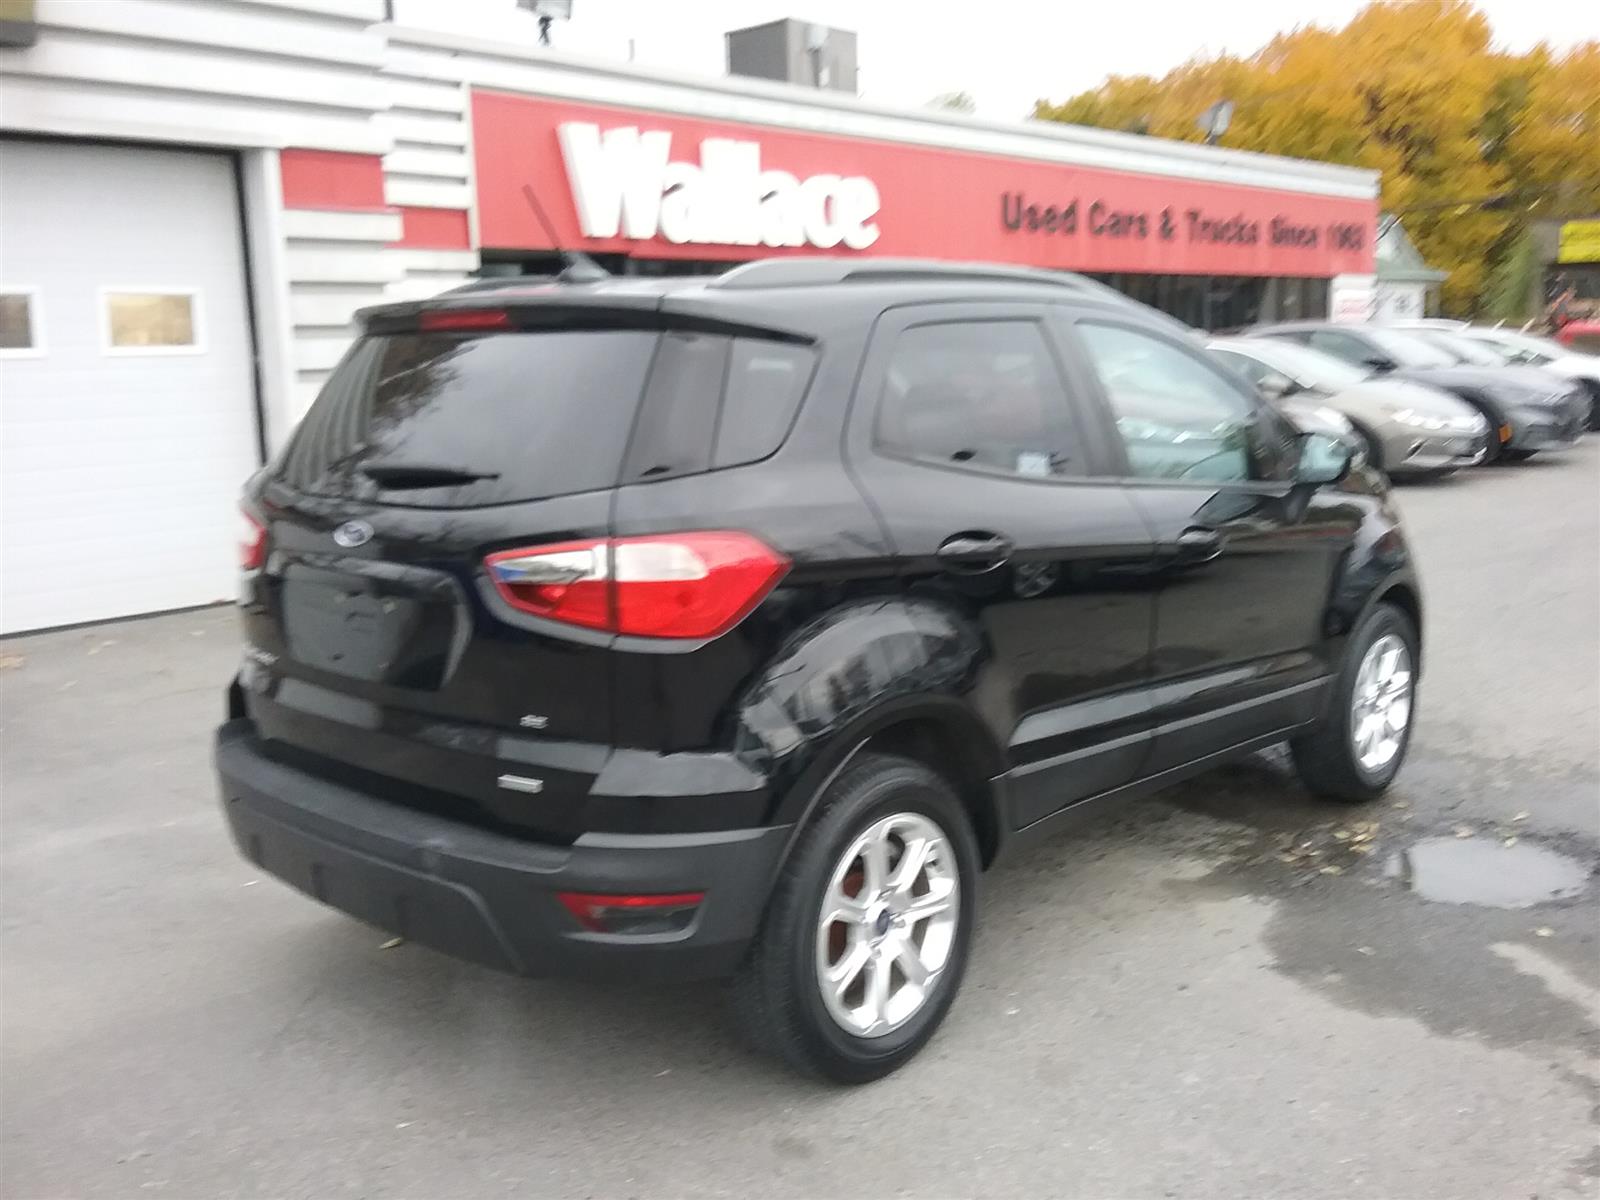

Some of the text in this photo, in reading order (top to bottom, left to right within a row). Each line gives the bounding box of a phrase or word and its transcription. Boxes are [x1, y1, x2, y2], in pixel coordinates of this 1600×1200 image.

[556, 121, 880, 249] Wallace
[1001, 191, 1078, 234] Used
[1089, 199, 1148, 239] Cars
[1160, 205, 1176, 241] &
[1187, 207, 1258, 245] Trucks
